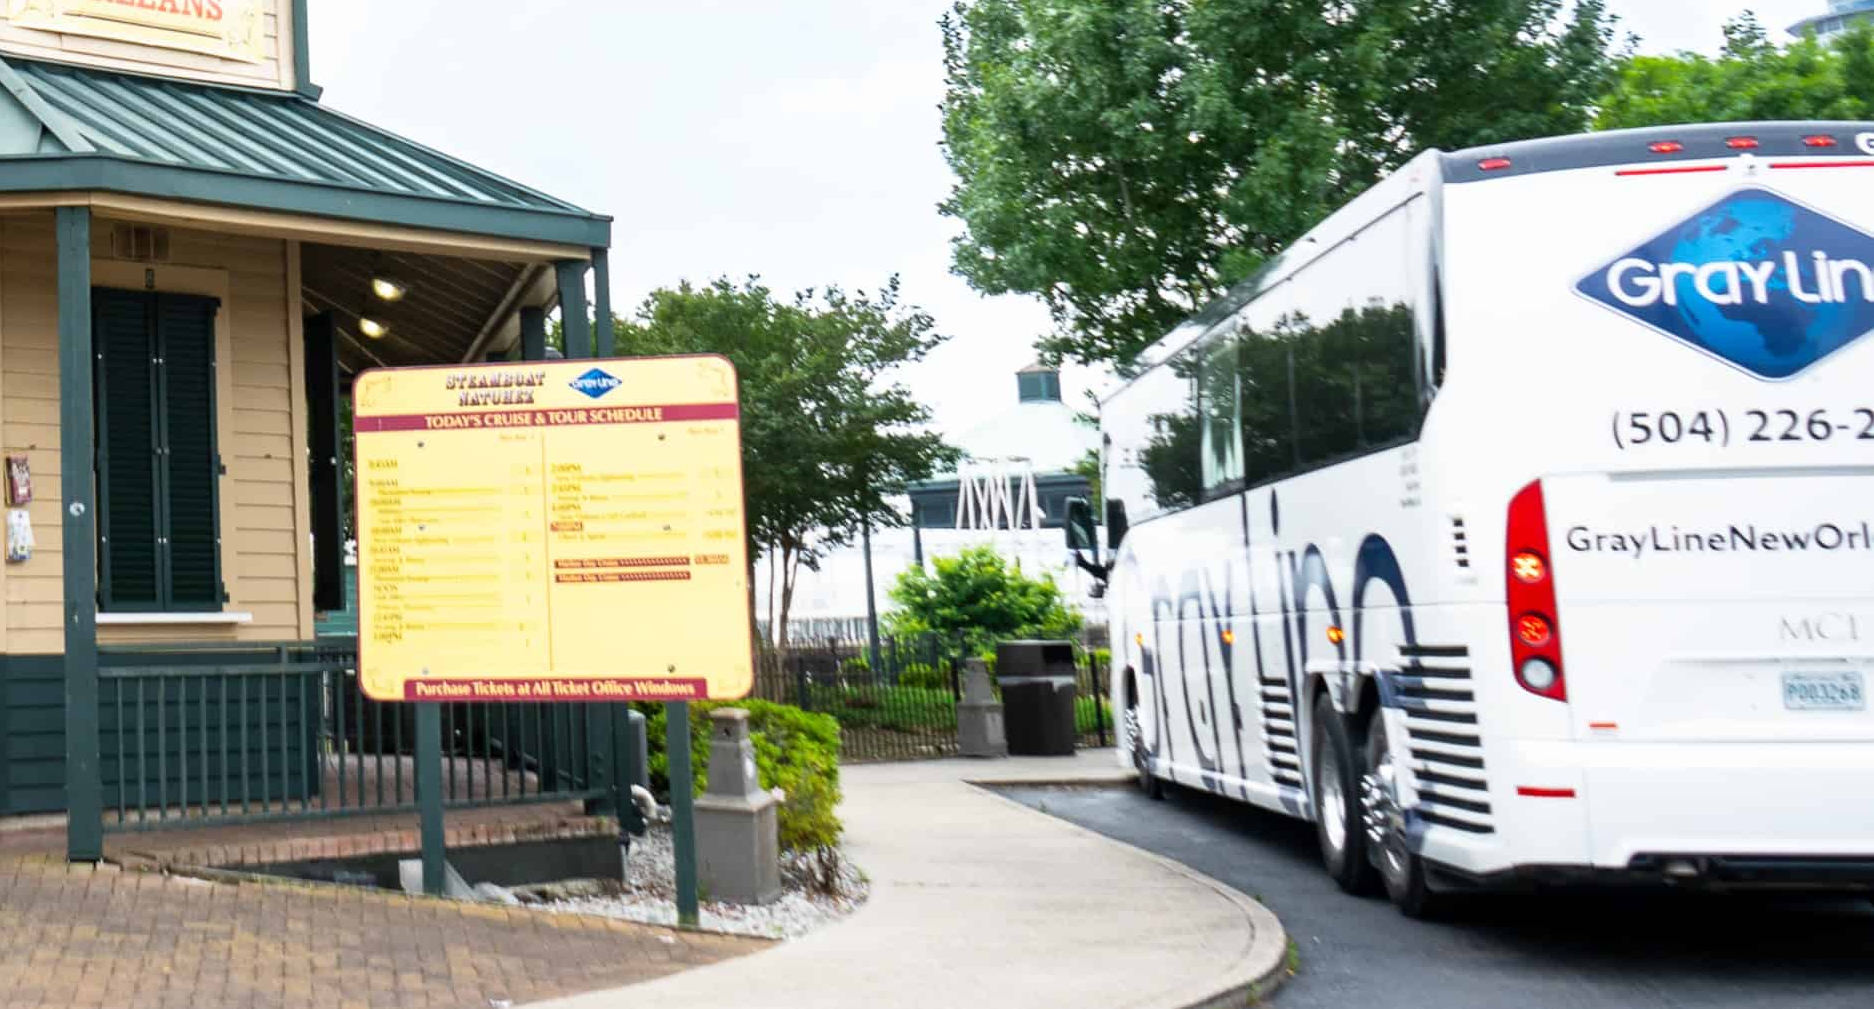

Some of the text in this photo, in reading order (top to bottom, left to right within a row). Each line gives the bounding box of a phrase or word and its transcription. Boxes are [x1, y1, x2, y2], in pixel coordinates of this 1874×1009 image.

[446, 373, 546, 390] STEAMBOAT
[458, 390, 535, 407] NATCHEZ
[425, 406, 663, 429] TODAY'S CRUISE & TOUR SCHEDULE
[1612, 409, 1729, 450] (504)
[1566, 522, 1874, 559] GrayLineNewOrl
[1780, 613, 1860, 642] MCI
[415, 680, 696, 697] Purchase Tickets at All Ticket Office Windows
